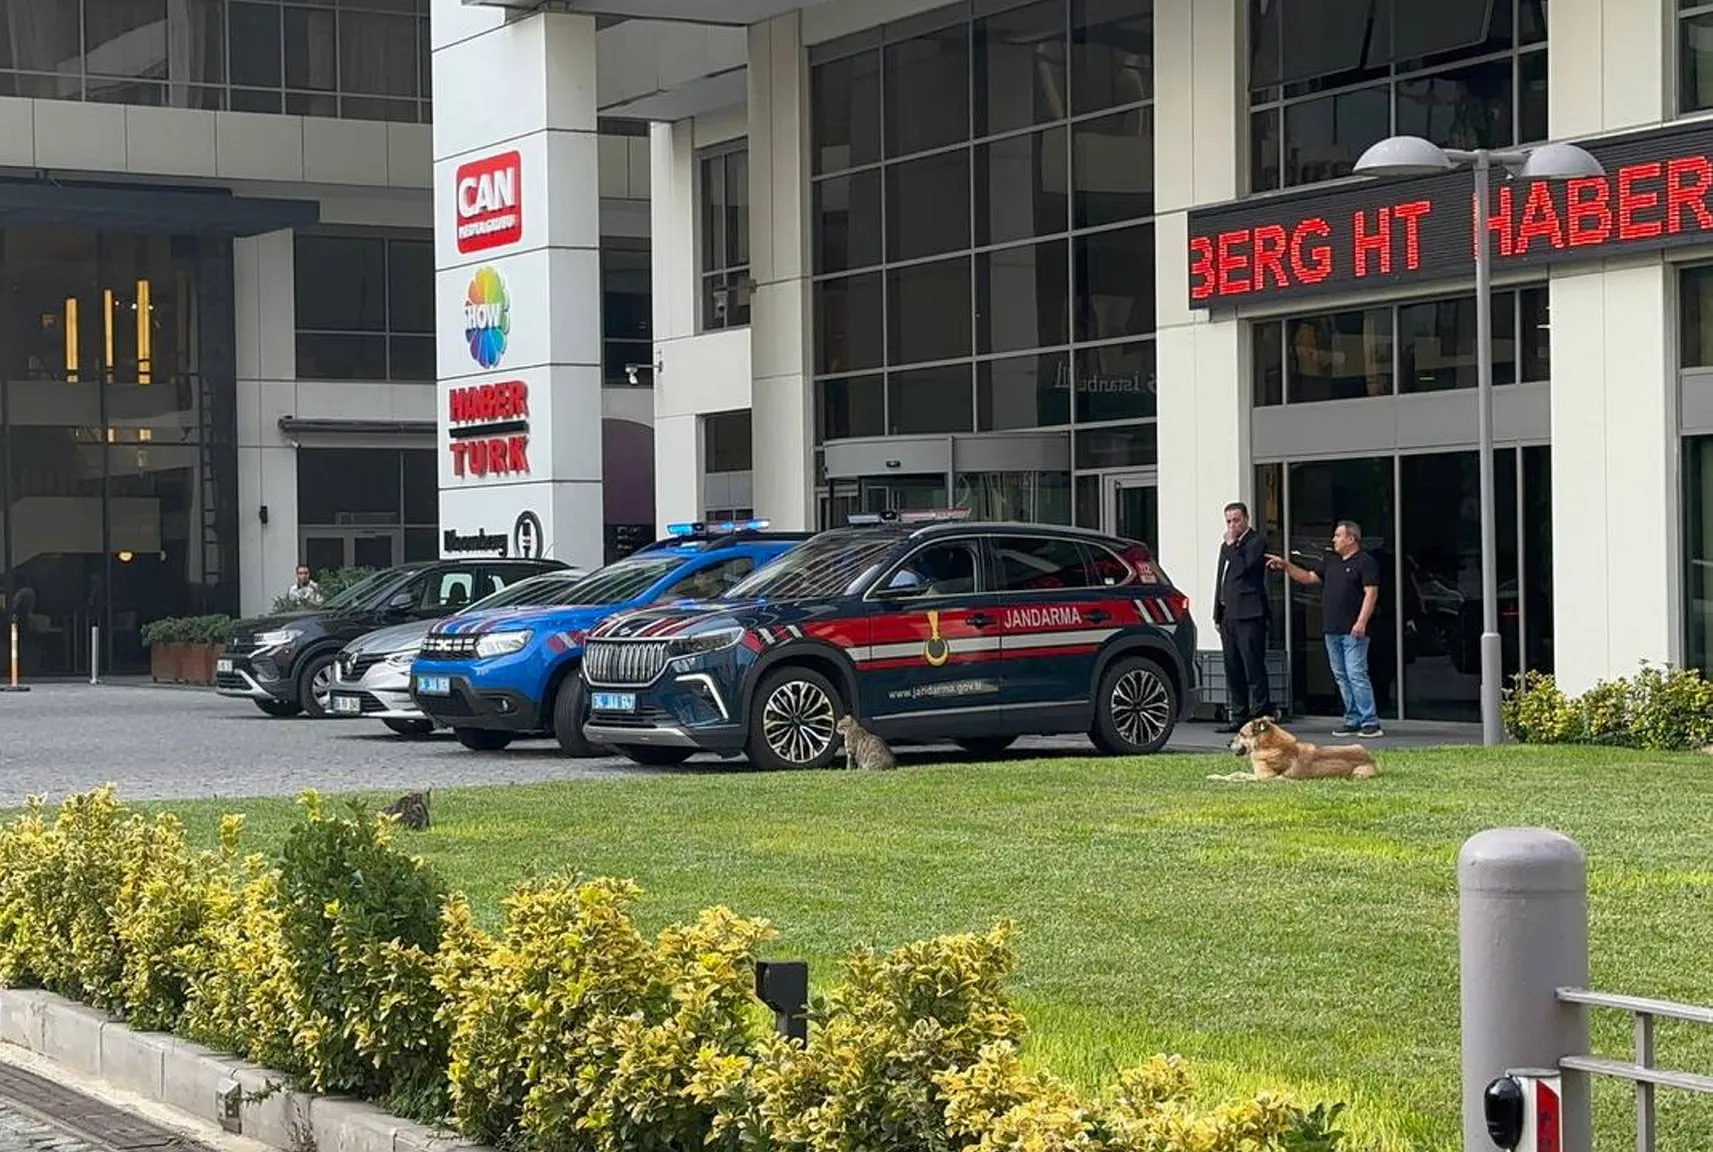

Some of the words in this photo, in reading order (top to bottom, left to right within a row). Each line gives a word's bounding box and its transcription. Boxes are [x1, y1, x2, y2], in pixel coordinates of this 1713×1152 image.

[459, 166, 516, 217] CAN
[1354, 200, 1431, 277] HT
[1473, 155, 1713, 260] HABER
[449, 380, 529, 424] HABER
[1004, 607, 1082, 629] JANDARMA
